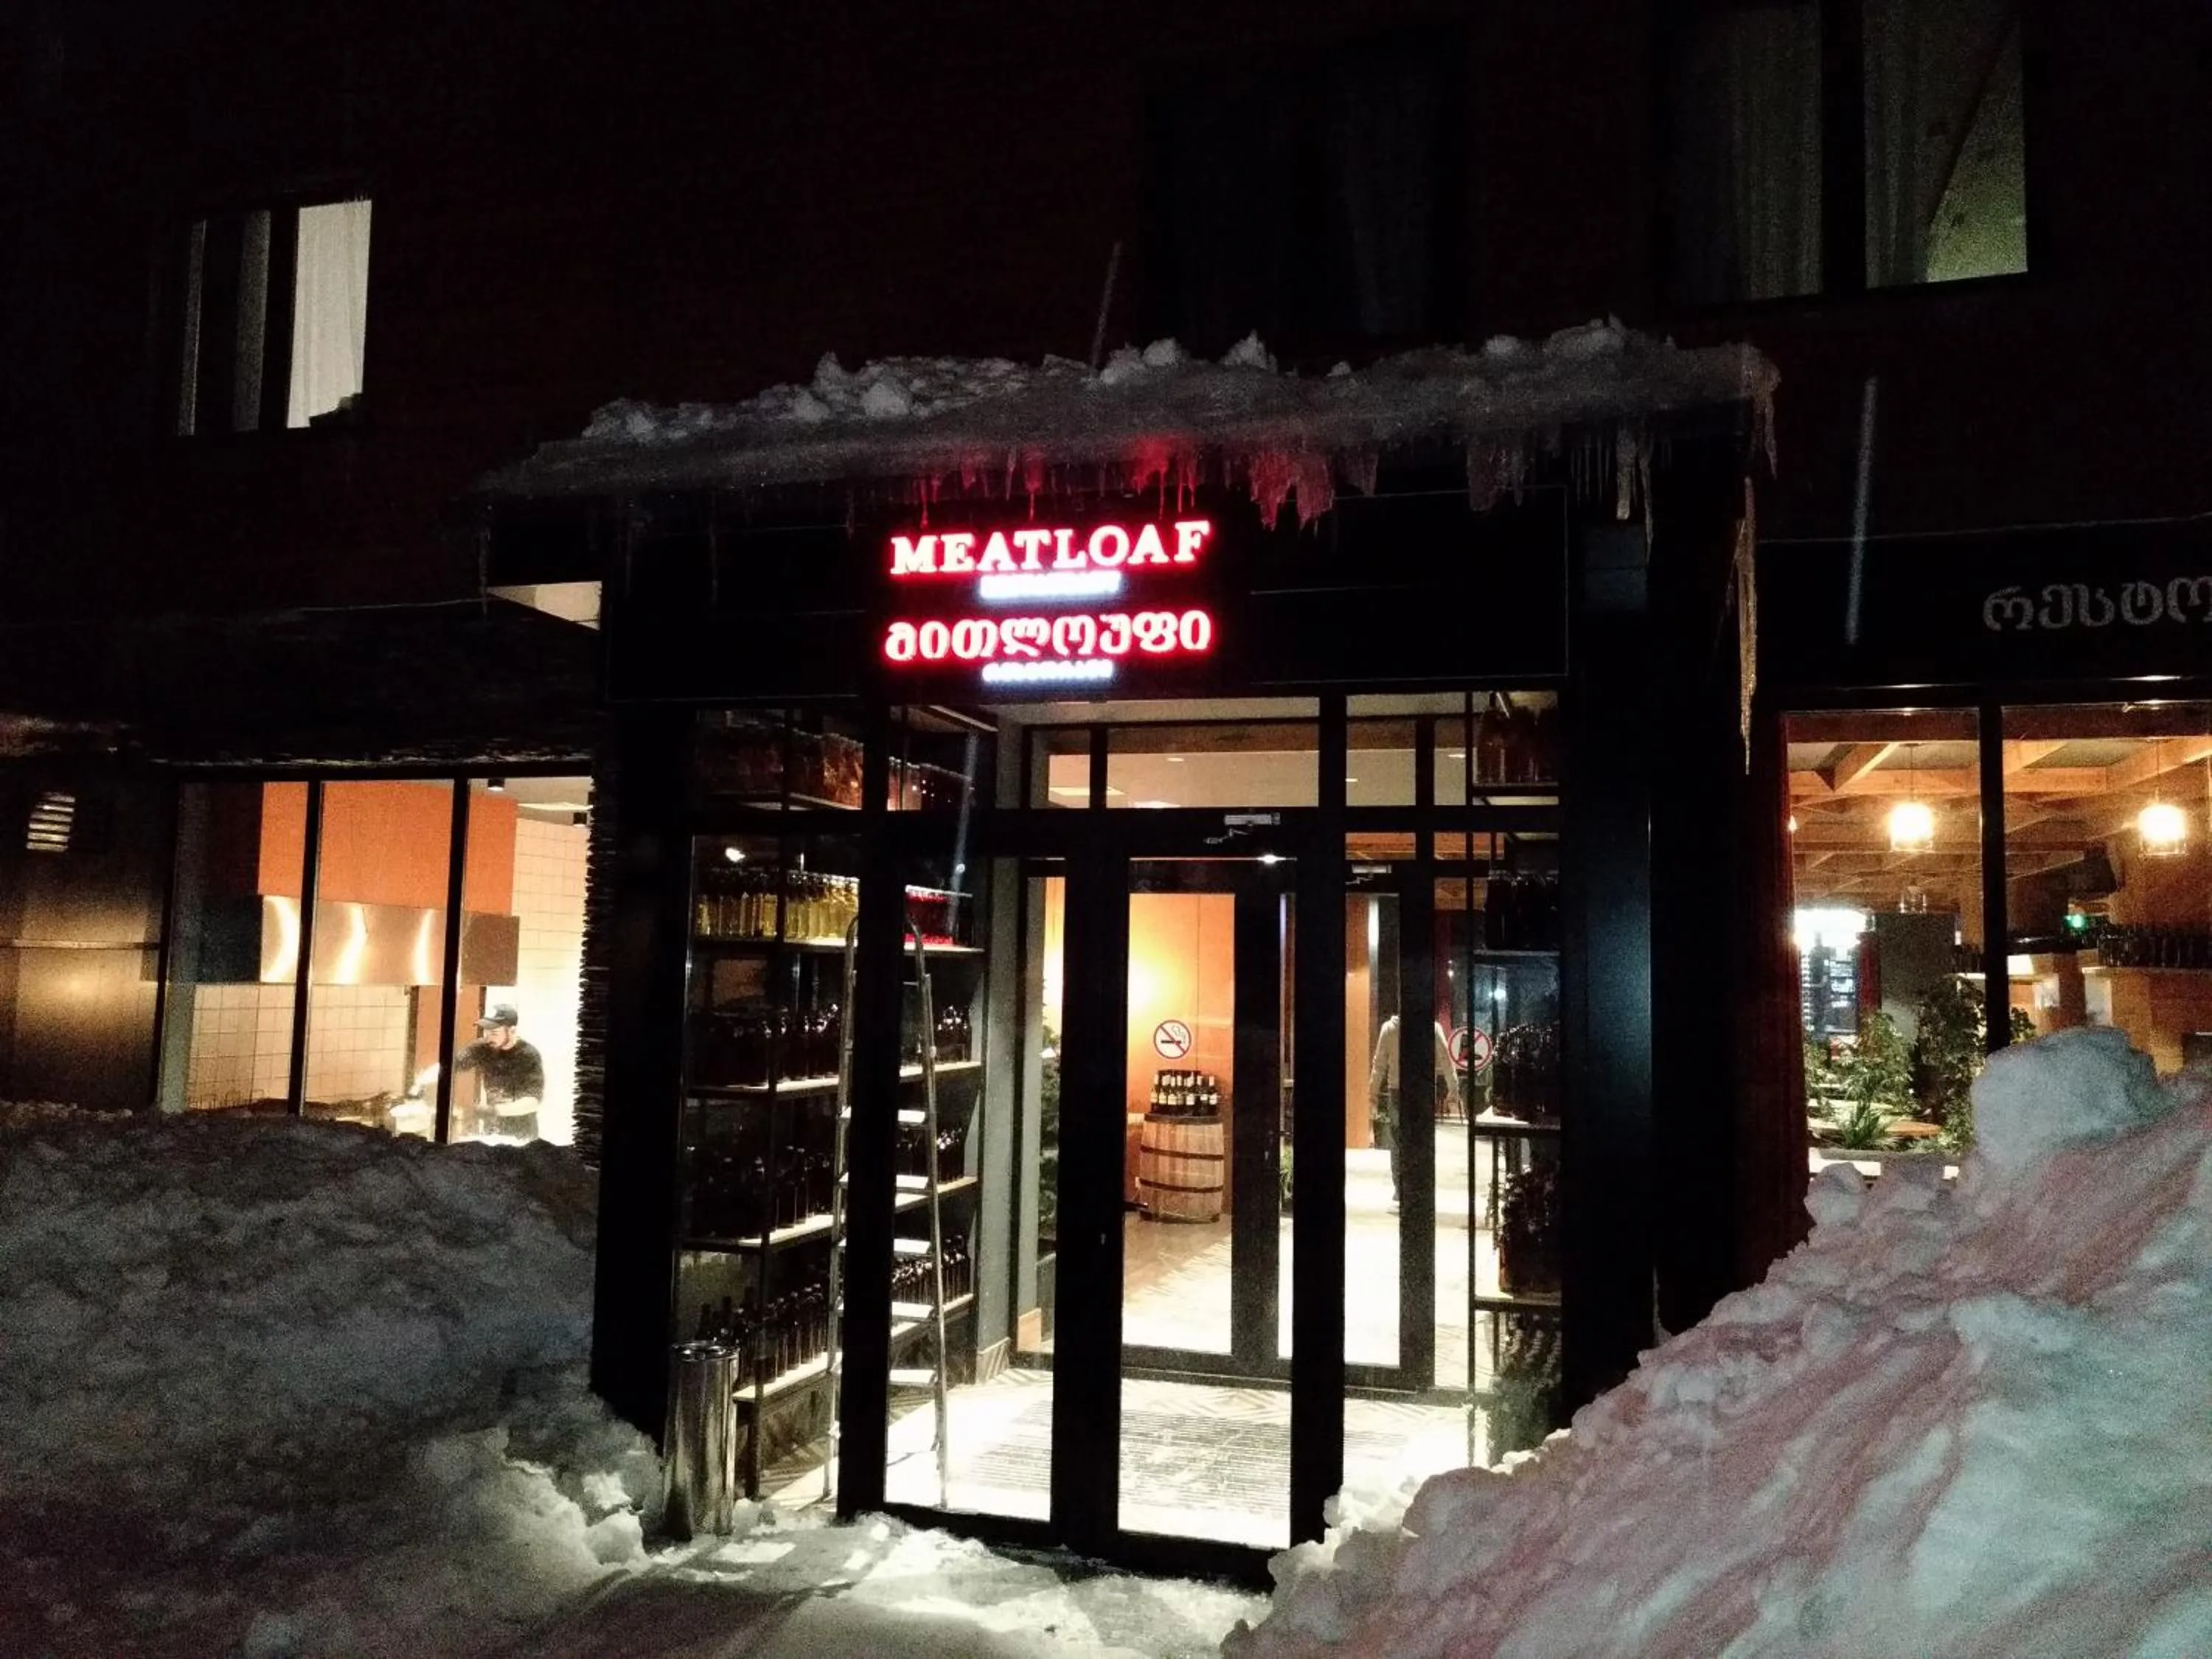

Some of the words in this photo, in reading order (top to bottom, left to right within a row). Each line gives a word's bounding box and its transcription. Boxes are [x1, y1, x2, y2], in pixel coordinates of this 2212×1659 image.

[889, 520, 1211, 575] MEATLOAF
[1983, 575, 2212, 630] რესტო
[885, 610, 1211, 661] მითლოუფი
